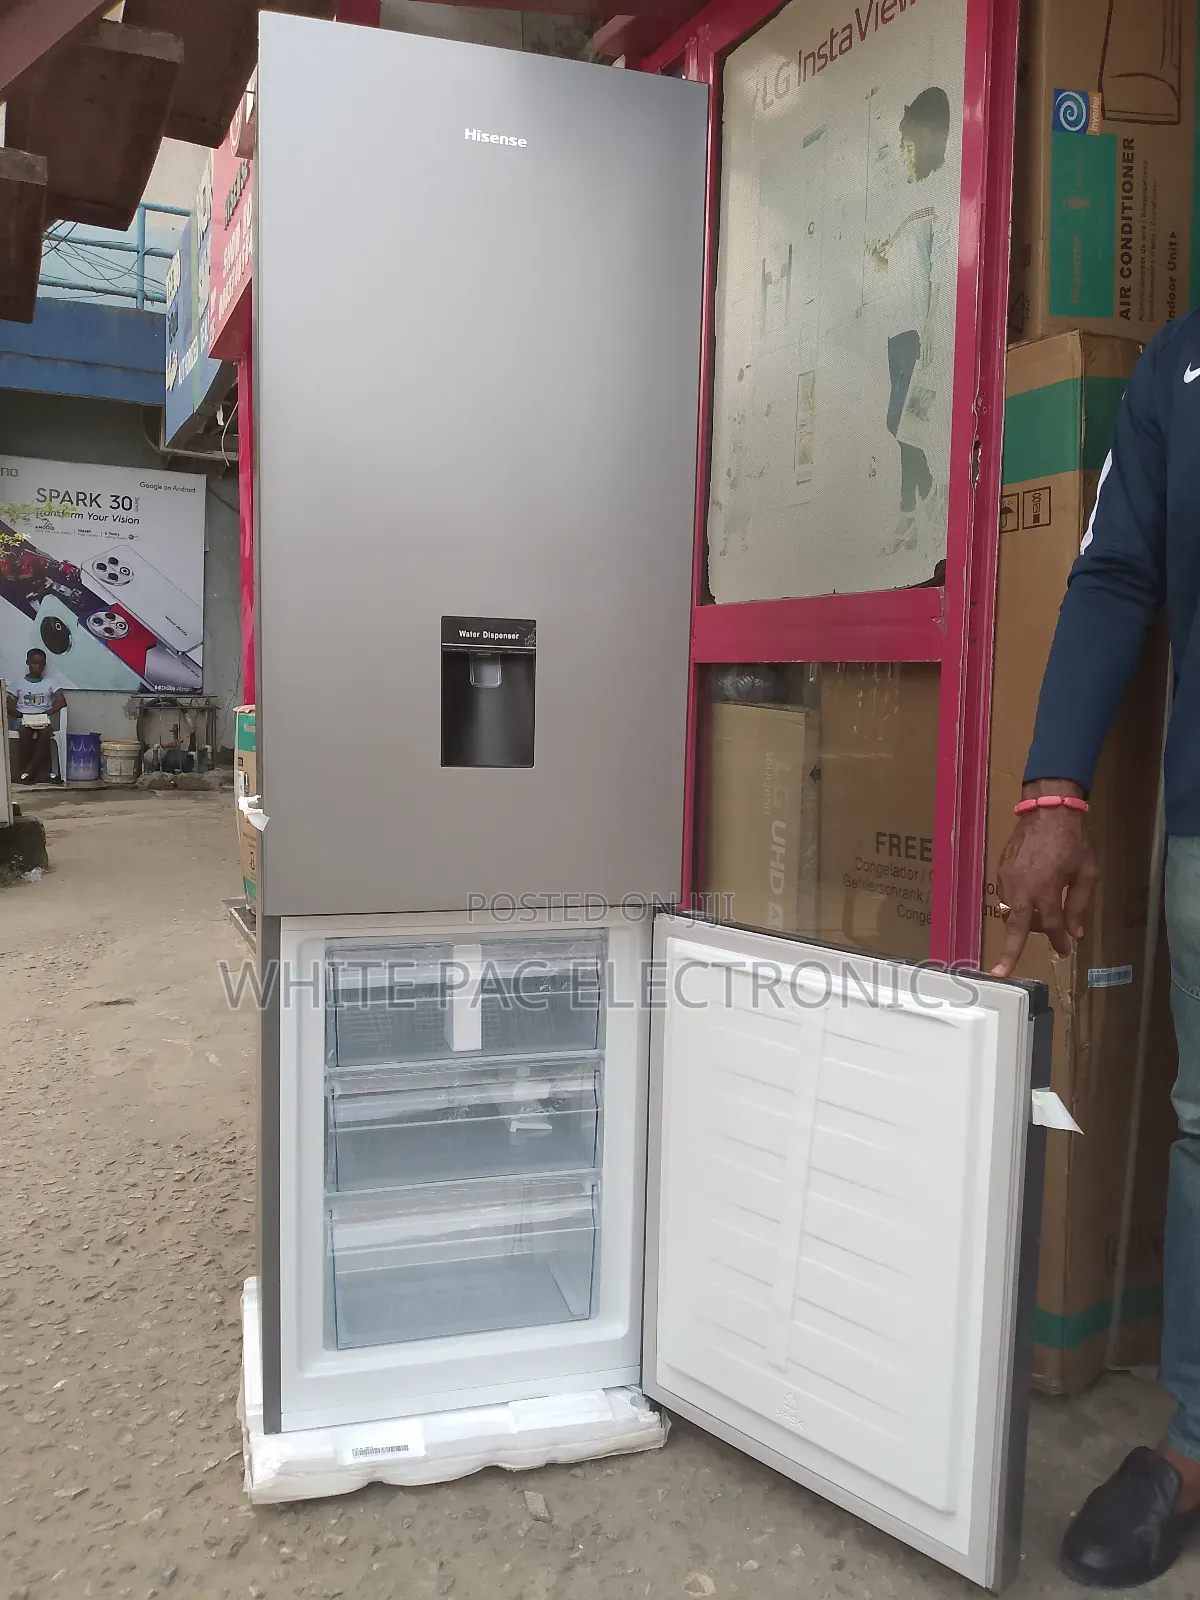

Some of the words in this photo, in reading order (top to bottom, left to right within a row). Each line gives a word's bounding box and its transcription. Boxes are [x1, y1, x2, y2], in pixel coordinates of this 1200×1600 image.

[1089, 96, 1101, 132] inverter
[464, 127, 528, 148] Hisense
[1119, 137, 1135, 279] CONDITIONER
[1167, 240, 1178, 272] Unit
[1119, 286, 1132, 321] AIR
[1166, 276, 1177, 323] Indoor
[35, 487, 102, 509] SPARK
[109, 494, 133, 511] 30
[139, 481, 162, 491] Google
[172, 485, 196, 493] Android
[87, 511, 109, 523] Your
[111, 514, 140, 525] Vision
[458, 629, 480, 639] Water
[482, 630, 520, 641] Dispenser
[769, 819, 787, 896] UHD
[854, 857, 919, 881] Congelador
[842, 873, 923, 901] Gefrierschrank
